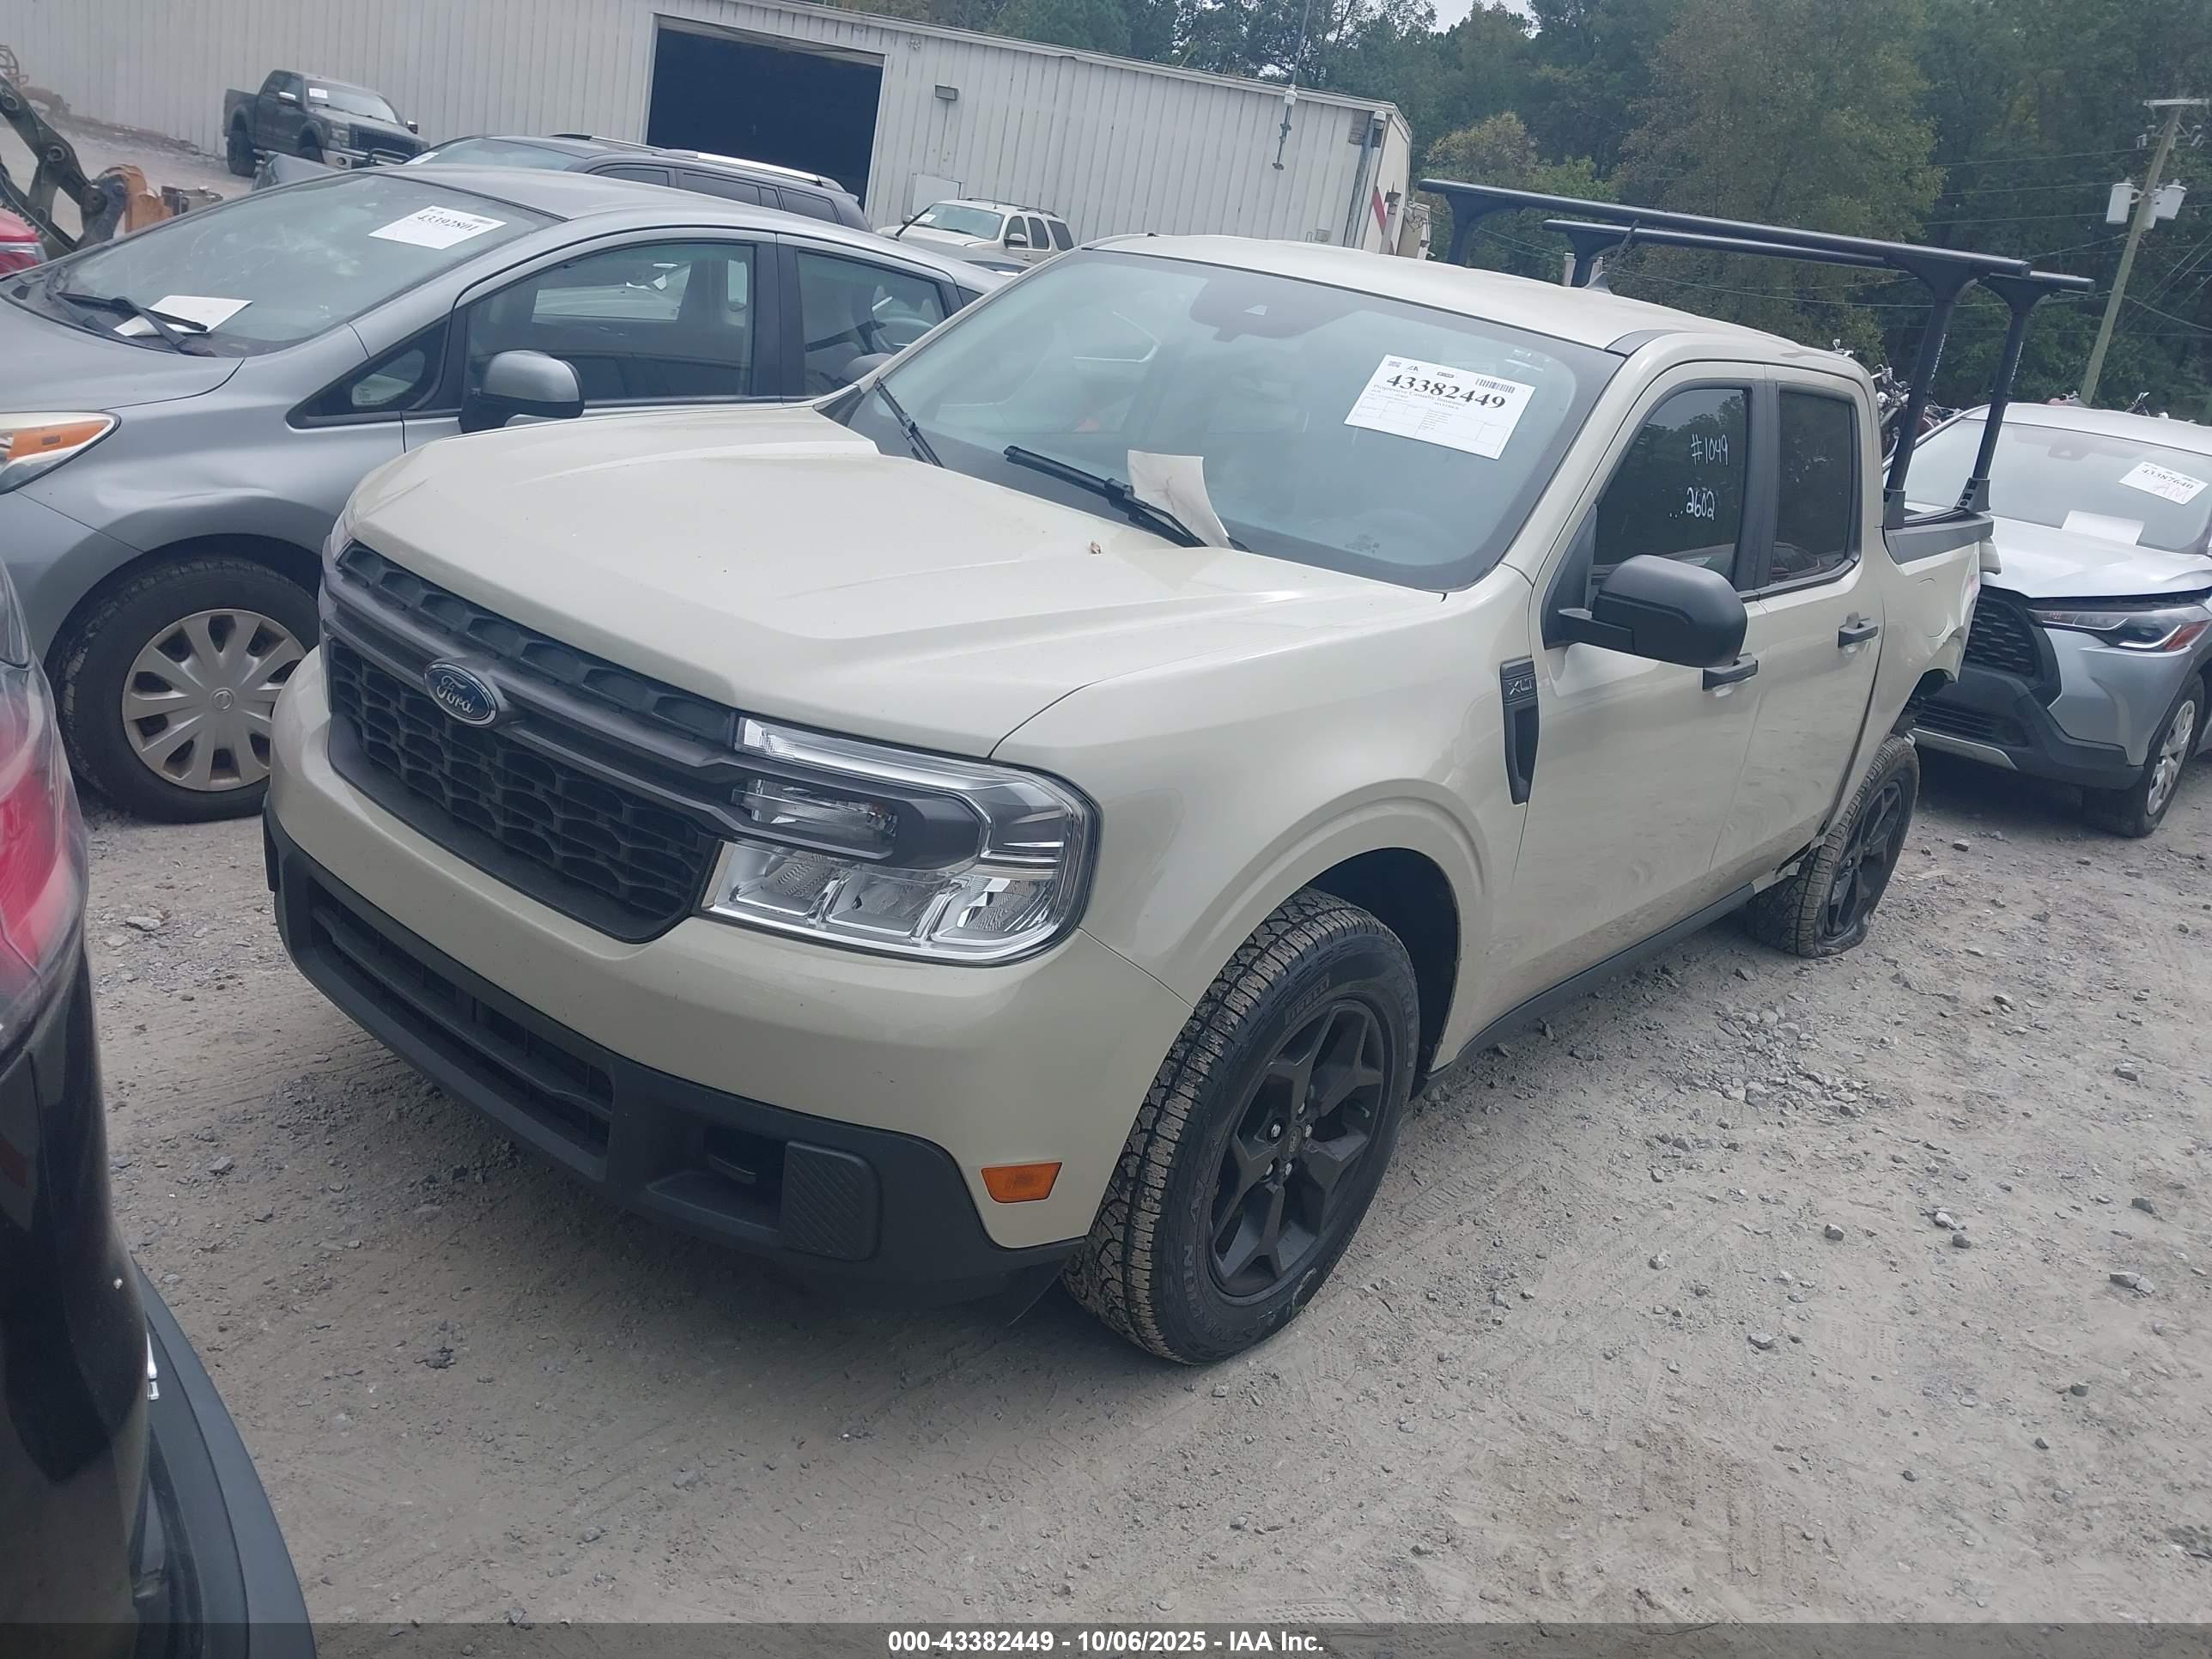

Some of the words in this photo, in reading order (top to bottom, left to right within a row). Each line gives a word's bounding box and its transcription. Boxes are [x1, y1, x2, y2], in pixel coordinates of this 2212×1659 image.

[1373, 383, 1408, 395] Progressive
[1409, 390, 1437, 401] Casualty
[1437, 396, 1468, 408] Insurance
[1386, 374, 1505, 408] 43382449
[1690, 434, 1729, 466] #1049
[436, 675, 475, 714] Ford
[1509, 679, 1533, 696] XLT
